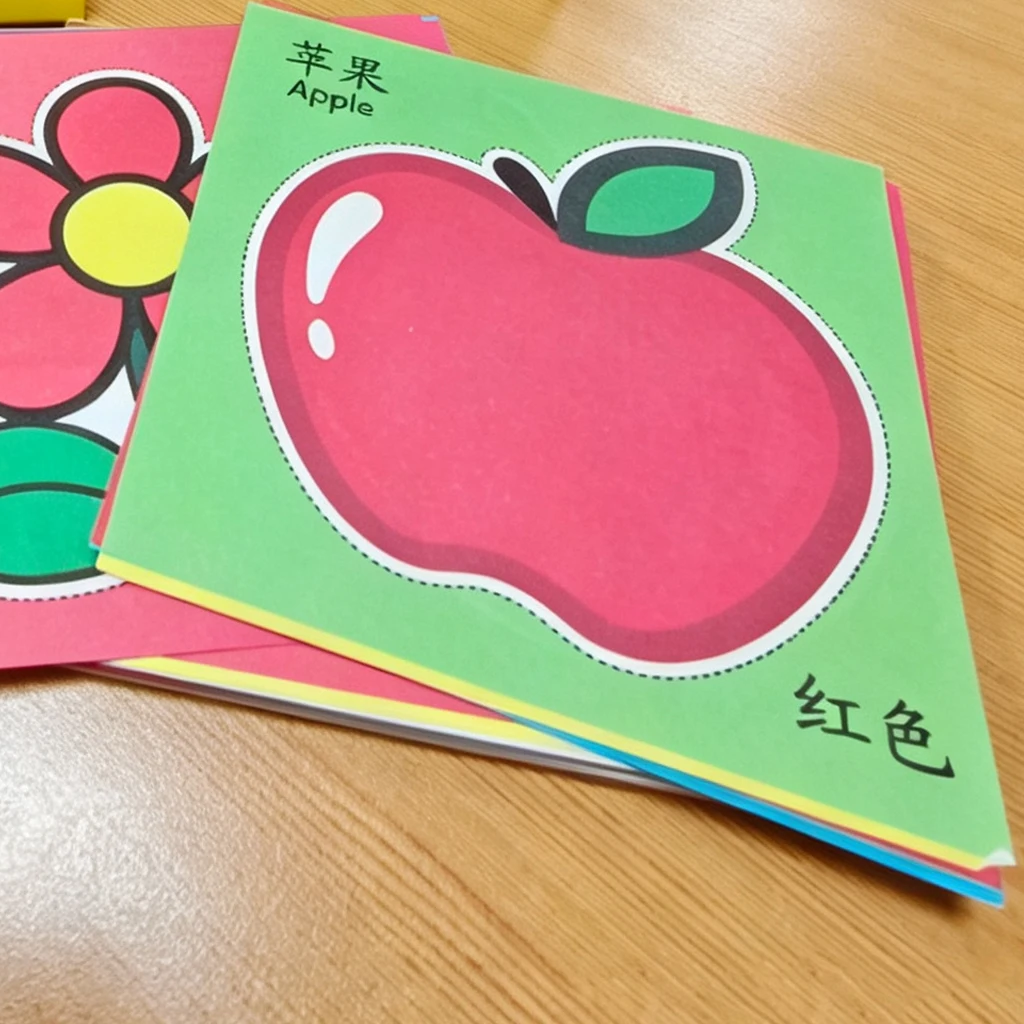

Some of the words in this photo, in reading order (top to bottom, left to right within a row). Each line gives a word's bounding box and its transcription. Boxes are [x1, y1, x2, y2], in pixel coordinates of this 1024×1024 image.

[286, 40, 389, 94] 苹果
[287, 79, 374, 116] Apple
[794, 673, 955, 779] 红色
